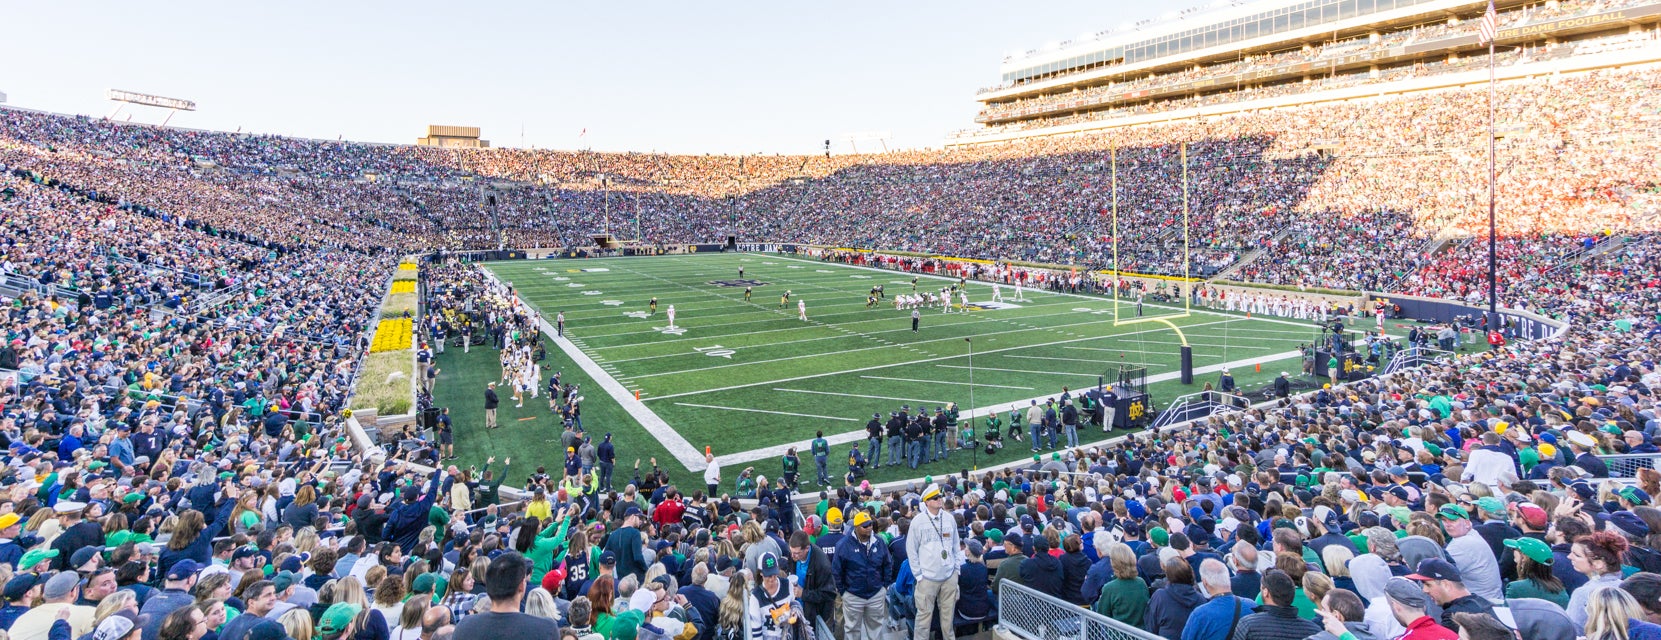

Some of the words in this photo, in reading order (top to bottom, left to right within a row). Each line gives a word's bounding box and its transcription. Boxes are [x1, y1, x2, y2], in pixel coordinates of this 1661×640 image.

[1495, 29, 1519, 38] TRE
[1522, 22, 1555, 34] DAME
[1558, 12, 1626, 29] FOOTBALL
[736, 243, 760, 252] NOTRE
[764, 244, 781, 252] DAM
[148, 438, 156, 449] 7
[570, 564, 587, 582] 35
